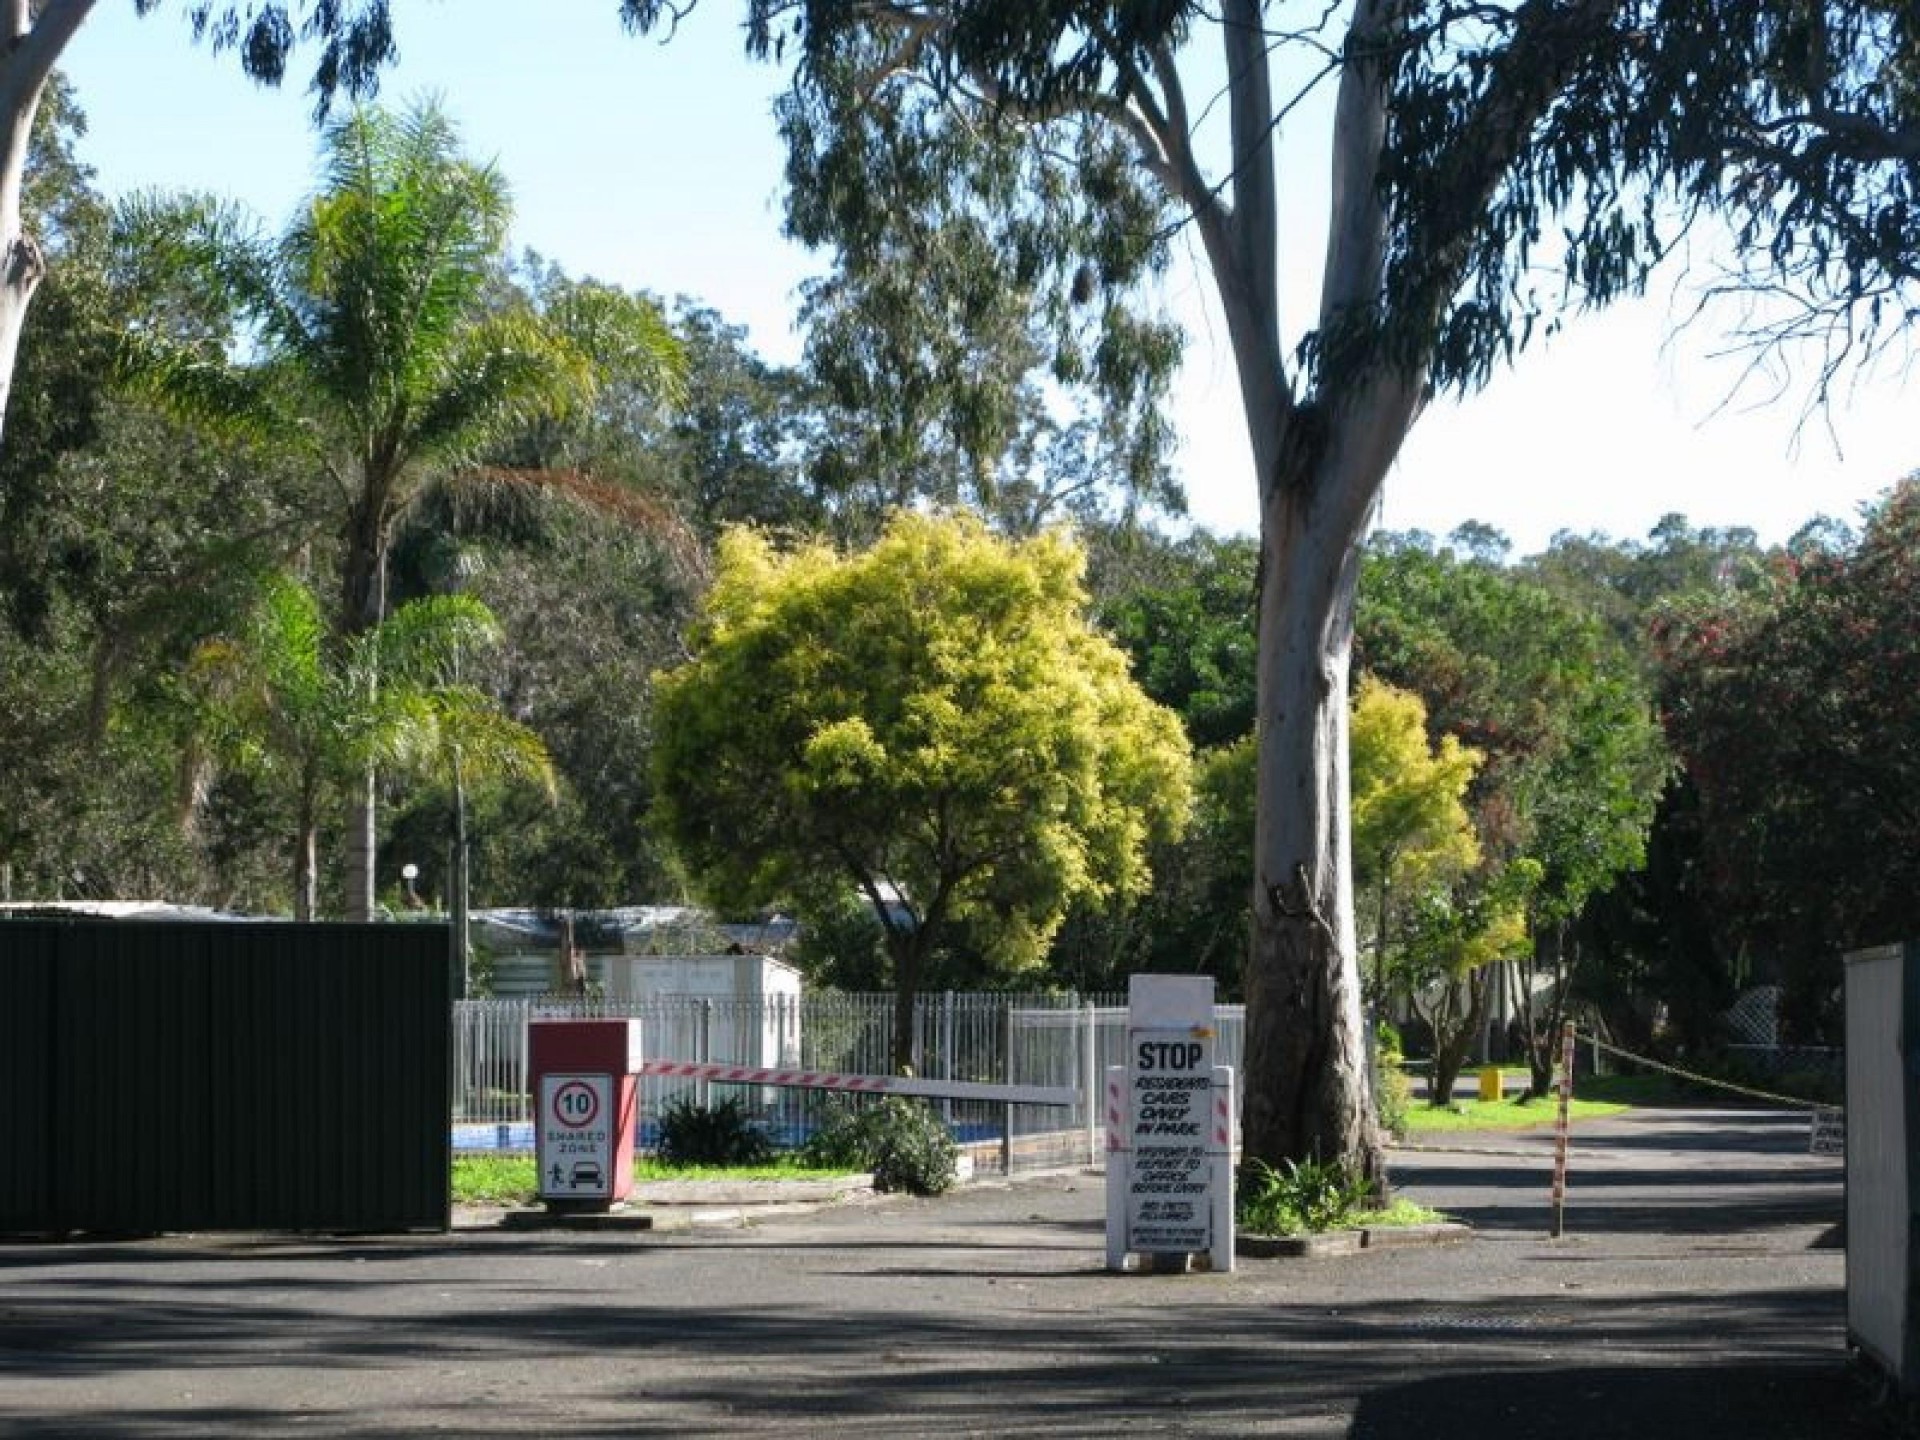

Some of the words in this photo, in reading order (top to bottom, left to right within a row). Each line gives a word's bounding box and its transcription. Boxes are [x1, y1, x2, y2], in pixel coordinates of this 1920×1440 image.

[1138, 1041, 1203, 1070] STOP
[563, 1093, 589, 1115] 10
[1141, 1091, 1191, 1105] CARS
[1135, 1122, 1154, 1134] IN
[1154, 1122, 1200, 1135] PARK
[547, 1132, 606, 1142] SHARED
[559, 1143, 597, 1153] ZONE
